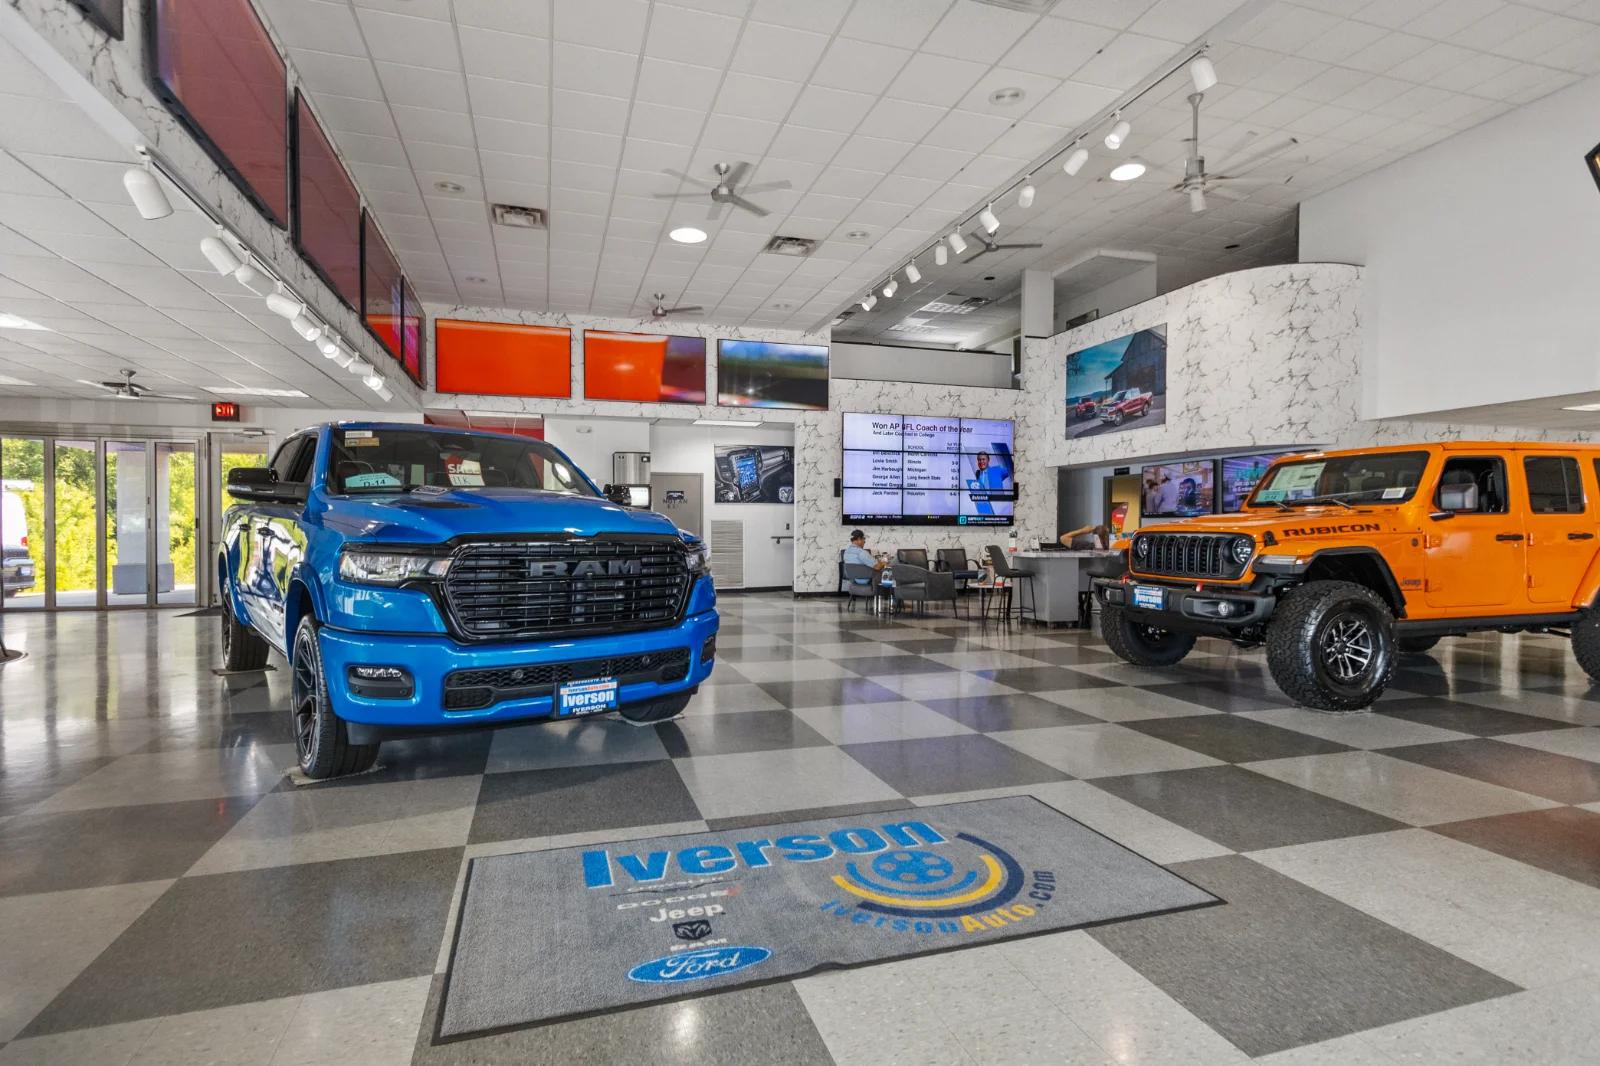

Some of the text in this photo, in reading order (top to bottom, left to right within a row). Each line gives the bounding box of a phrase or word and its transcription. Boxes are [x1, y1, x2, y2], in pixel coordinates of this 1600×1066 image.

[872, 422, 888, 430] Won
[889, 422, 900, 430] AP
[916, 424, 938, 432] Coach
[939, 424, 946, 432] of
[947, 425, 959, 433] the
[1282, 523, 1381, 537] RUBICON
[530, 560, 641, 577] RAM
[562, 690, 615, 708] Iverson
[572, 703, 607, 713] IVERSON
[581, 821, 950, 890] Iverson
[617, 888, 730, 911] DODGE
[649, 903, 725, 923] Jeep
[659, 951, 741, 978] Ford
